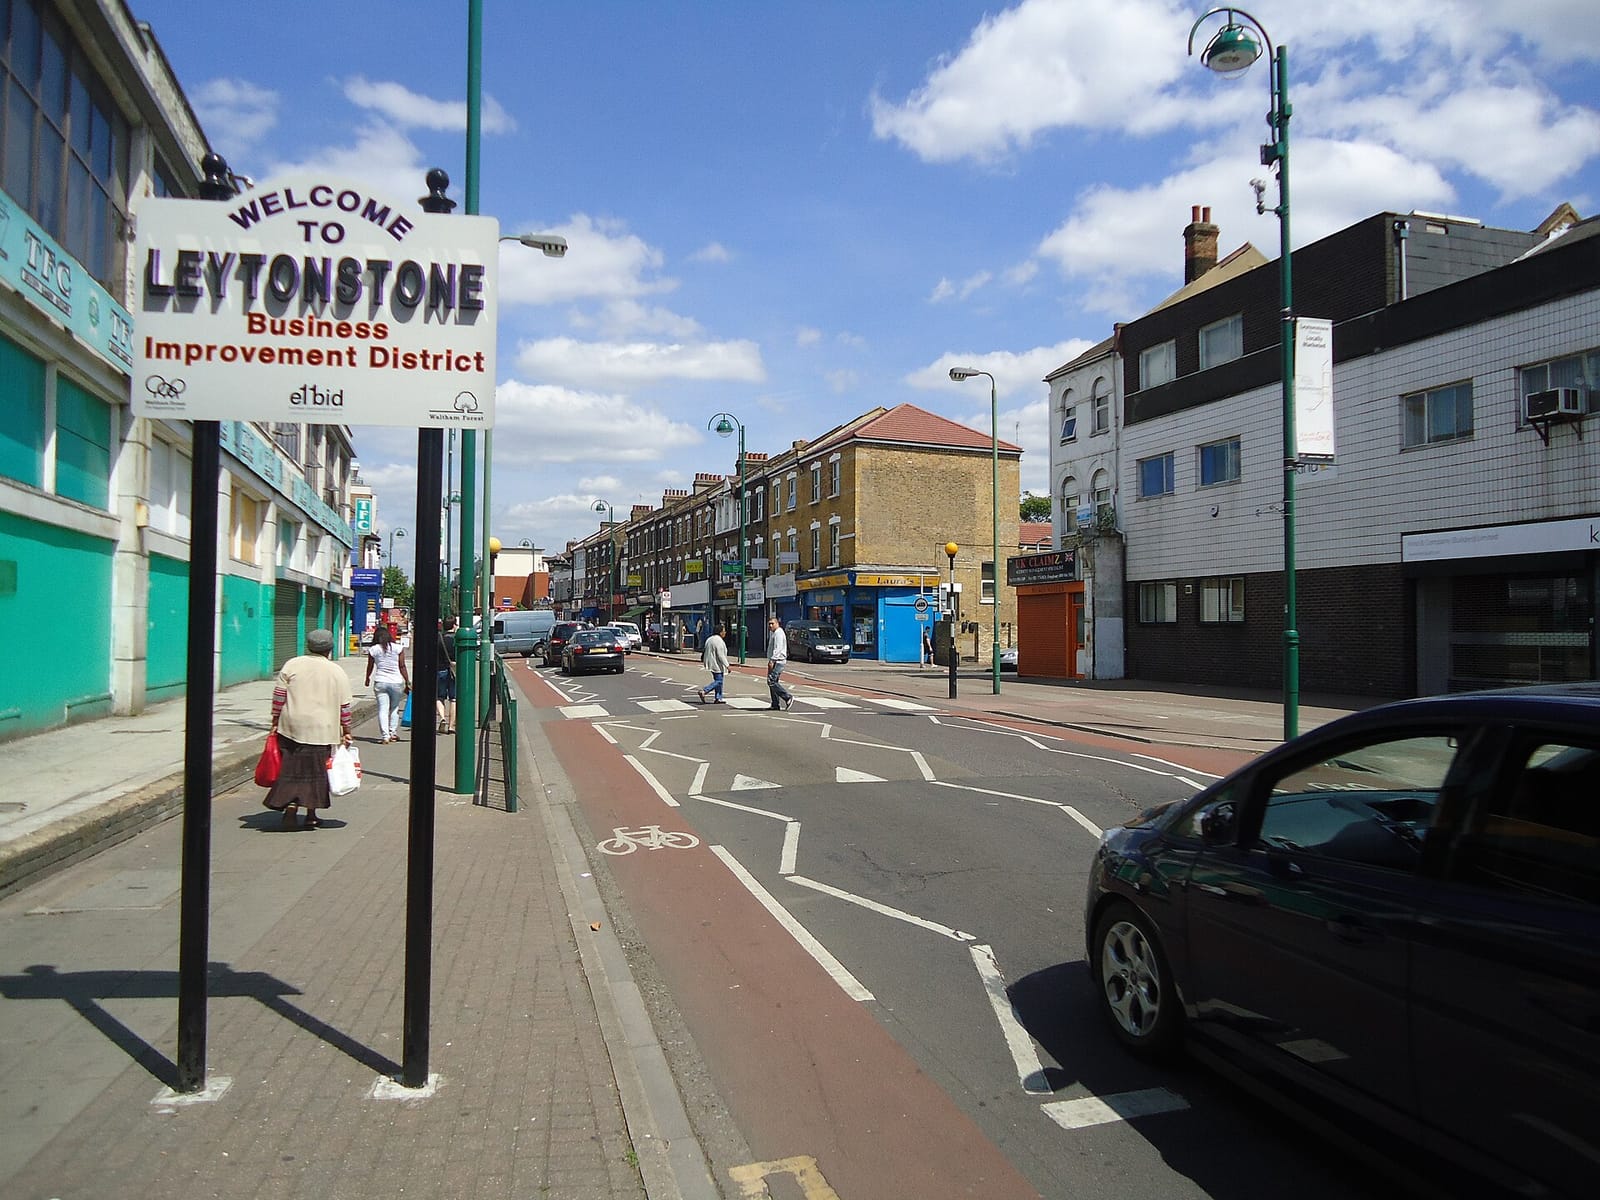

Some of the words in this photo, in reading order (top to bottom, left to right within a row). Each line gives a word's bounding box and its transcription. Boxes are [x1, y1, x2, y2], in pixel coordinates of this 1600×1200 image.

[227, 184, 414, 243] WELCOME
[297, 221, 345, 244] TO
[24, 228, 71, 299] TFC
[147, 248, 485, 311] LEYTONSTONE
[247, 311, 389, 340] Business
[145, 336, 357, 367] Improvement
[369, 346, 485, 373] District
[357, 500, 371, 531] TFC
